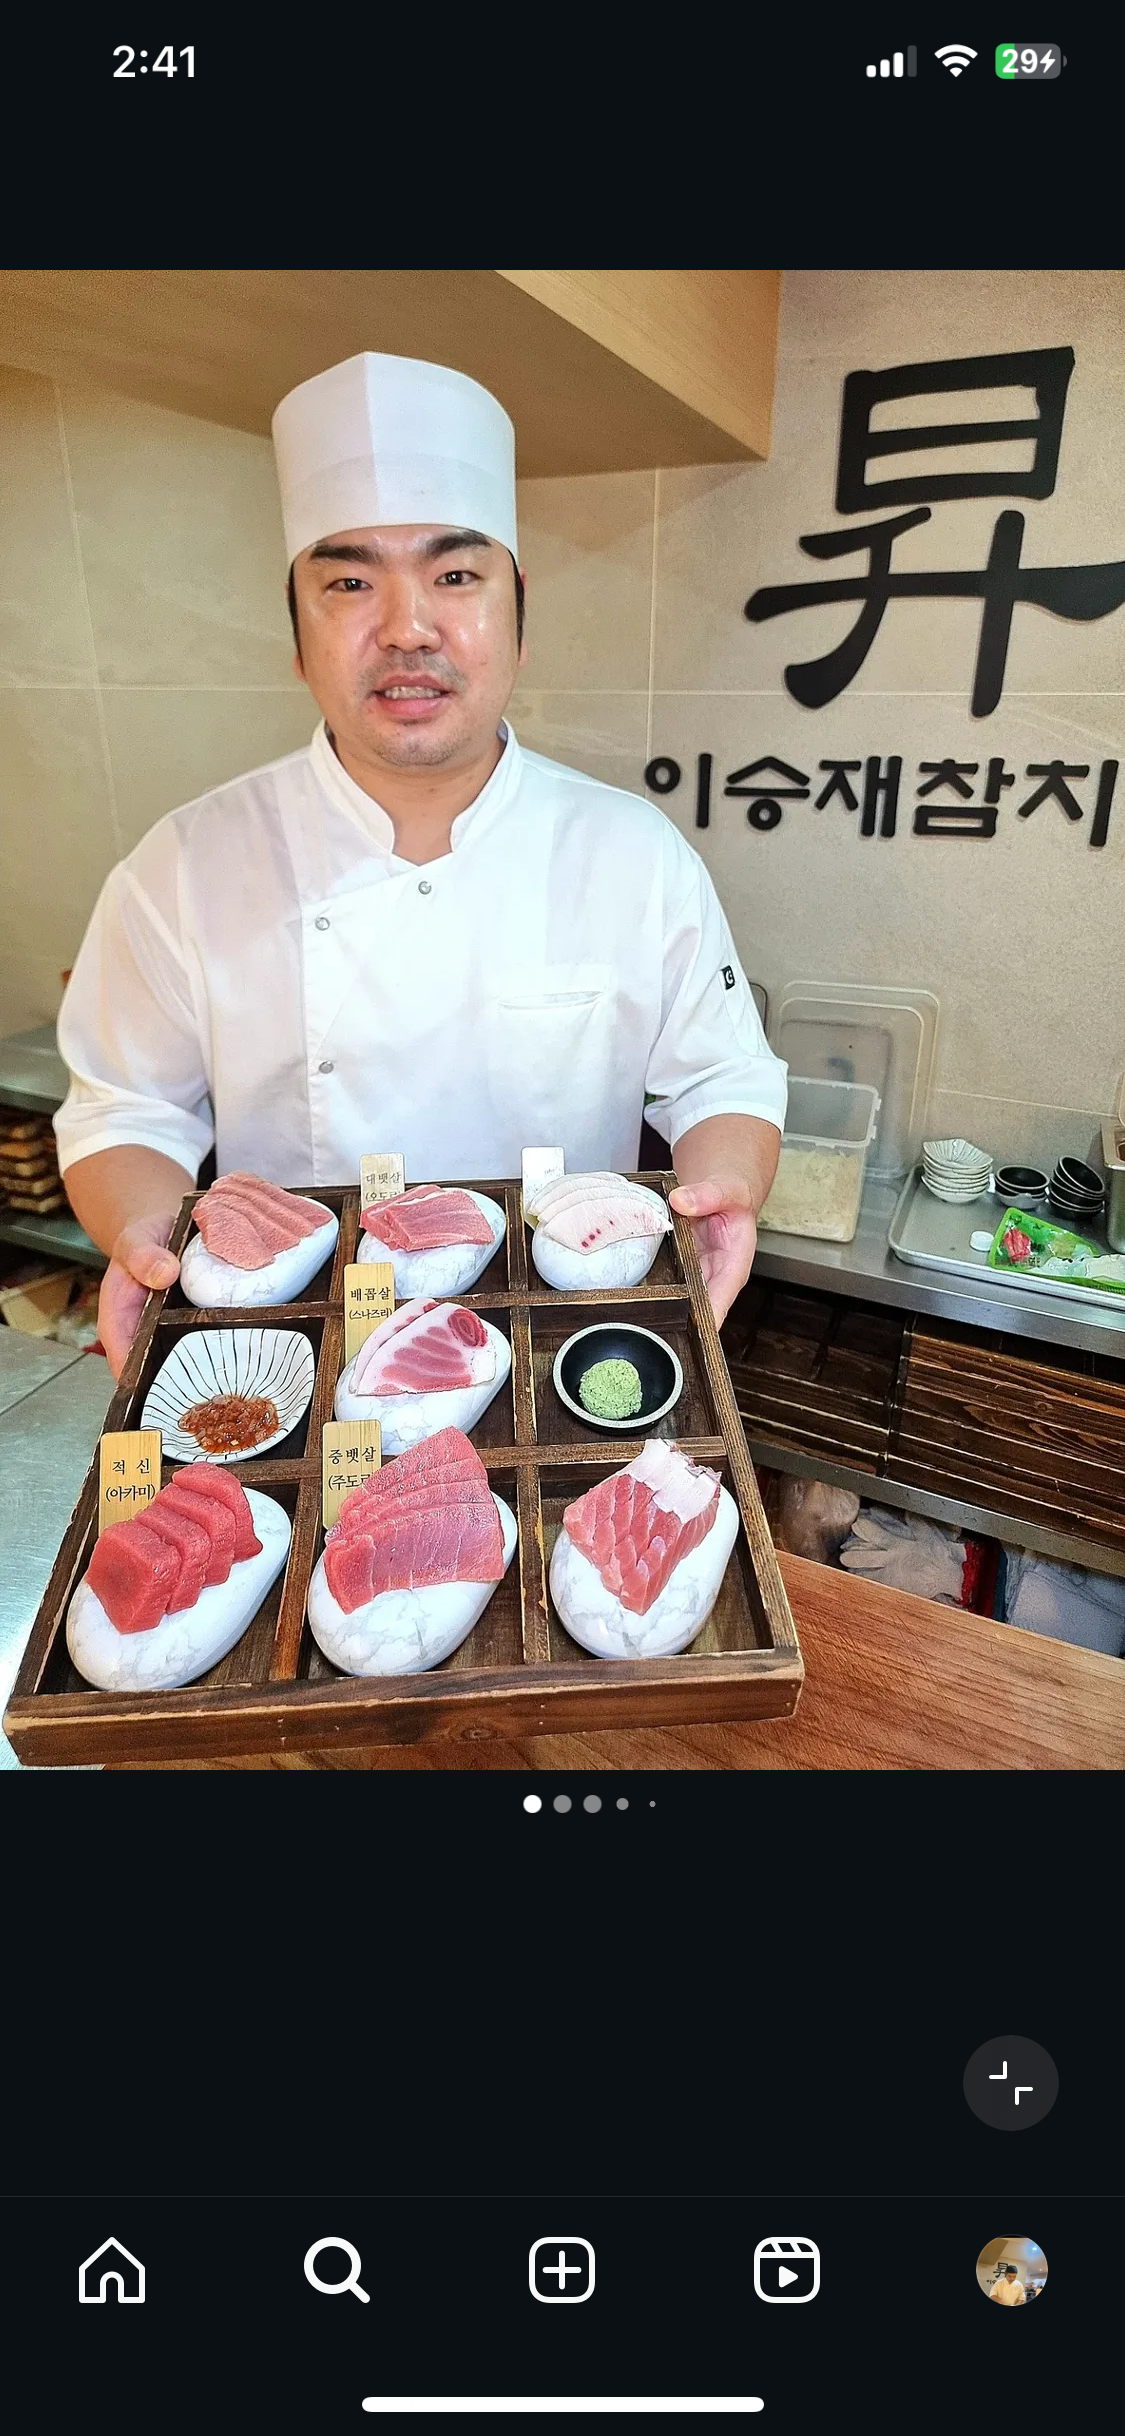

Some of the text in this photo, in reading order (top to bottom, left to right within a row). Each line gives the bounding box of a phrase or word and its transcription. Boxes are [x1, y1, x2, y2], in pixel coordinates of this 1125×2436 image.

[744, 346, 1125, 718] 昇
[645, 752, 1120, 848] 이승재참치
[365, 1171, 402, 1185] 대뱃살
[350, 1286, 392, 1301] 배꼽살
[348, 1308, 393, 1320] (스나즈리)
[328, 1445, 377, 1465] 중뱃살
[105, 1483, 156, 1503] (아카미)
